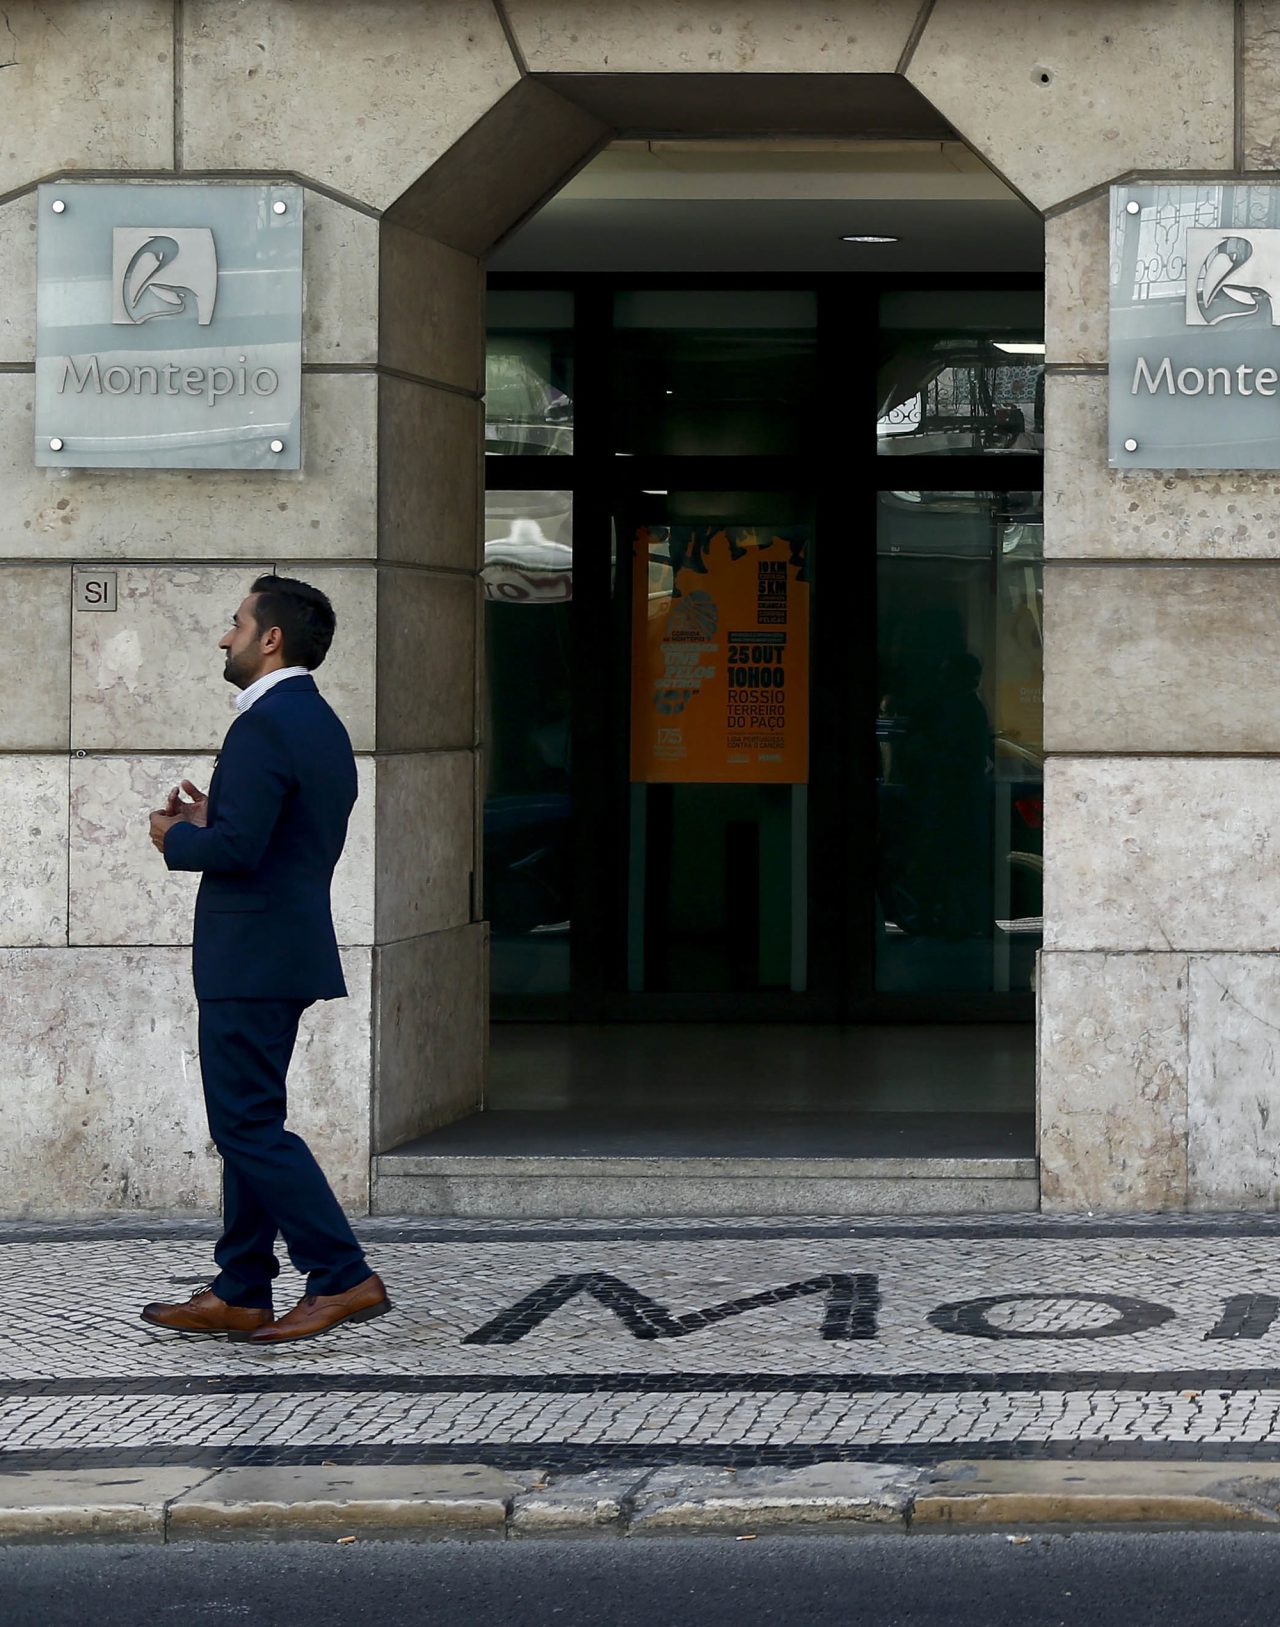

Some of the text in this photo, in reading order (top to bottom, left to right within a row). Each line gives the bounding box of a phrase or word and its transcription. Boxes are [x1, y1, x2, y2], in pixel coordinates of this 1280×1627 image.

[57, 355, 279, 407] Montepio
[84, 581, 108, 603] SI
[728, 645, 749, 664] 25
[751, 645, 785, 664] OUT
[727, 667, 785, 688] 10H00
[728, 690, 785, 704] ROSSIO
[727, 704, 785, 716] TERREIRO
[727, 717, 785, 731] DO PAÇO
